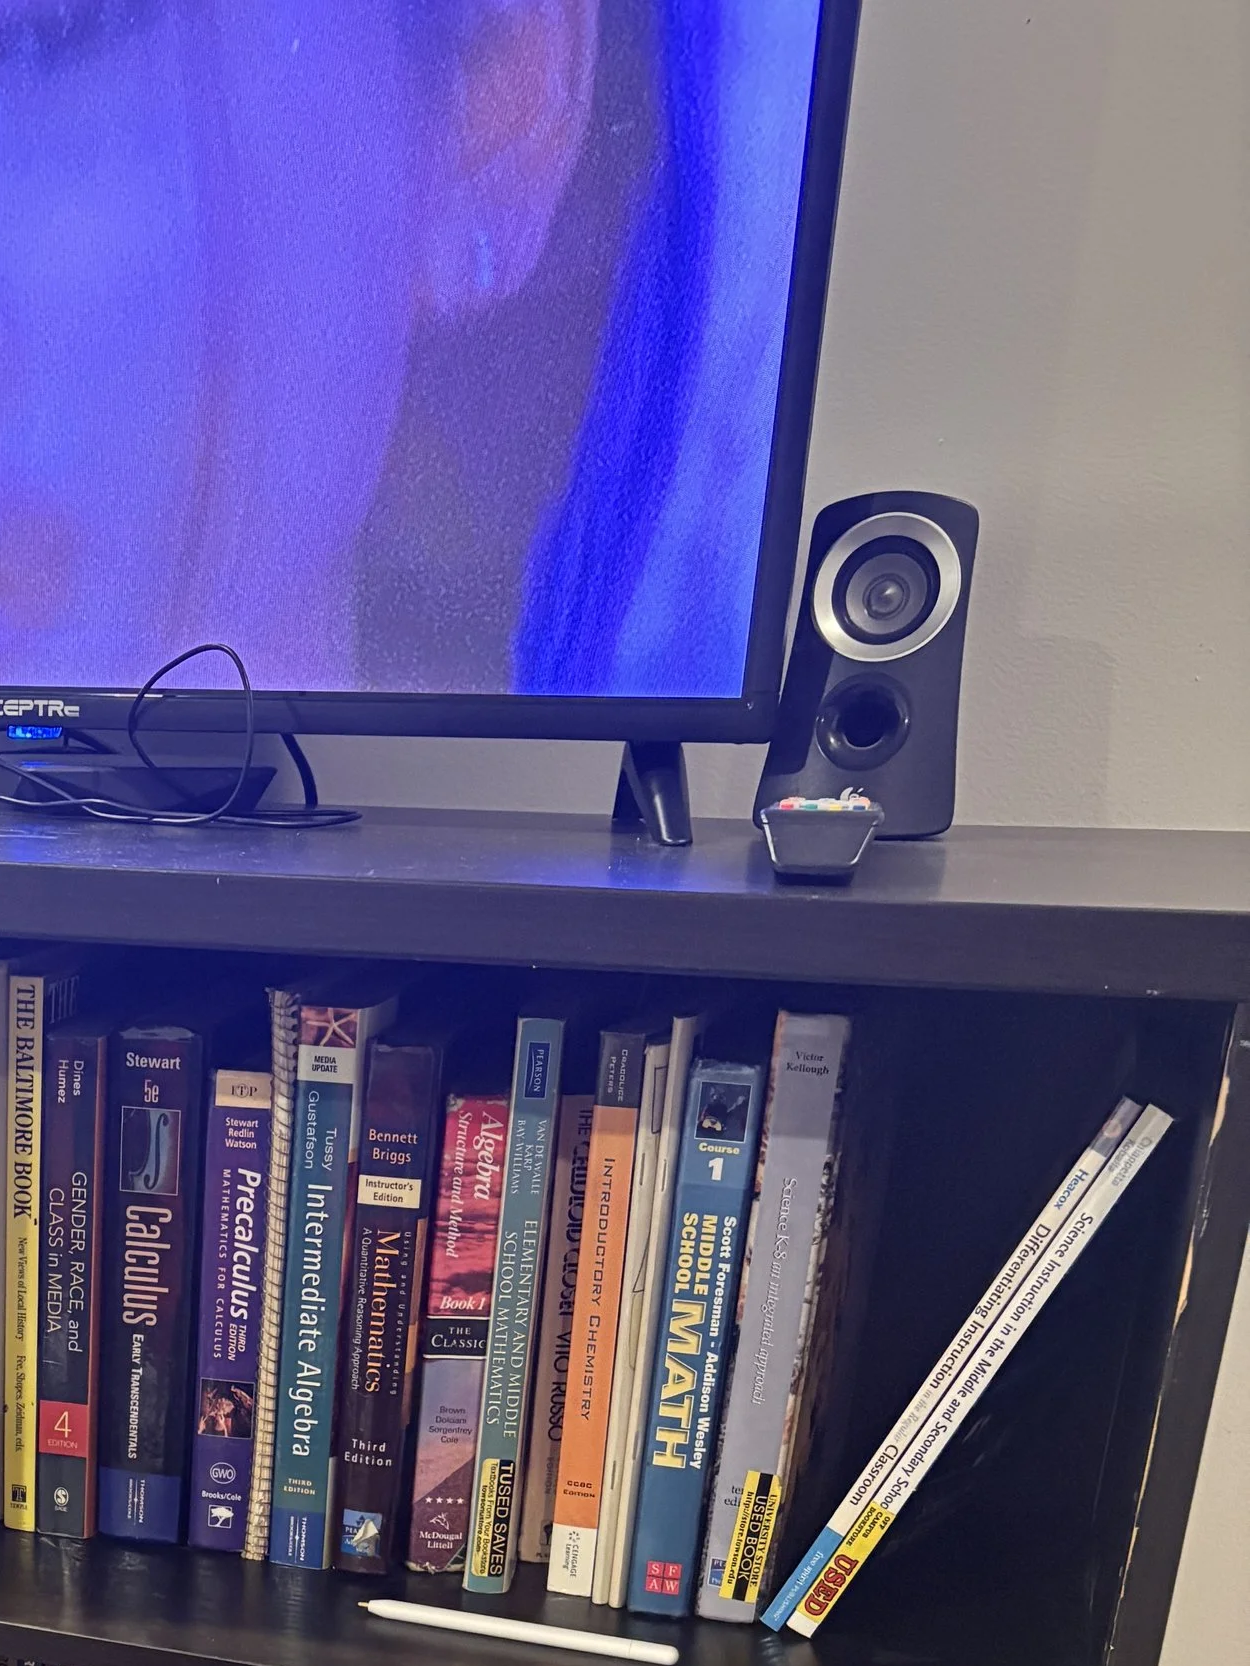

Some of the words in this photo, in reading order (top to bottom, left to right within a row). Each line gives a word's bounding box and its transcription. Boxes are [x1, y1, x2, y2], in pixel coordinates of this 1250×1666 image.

[16, 985, 36, 1030] THE
[73, 1060, 84, 1096] Dines
[125, 1051, 182, 1071] Stewart
[311, 1064, 338, 1074] UPDATE
[313, 1055, 337, 1065] MEDIA
[533, 1048, 545, 1093] PEARSON
[786, 1062, 830, 1076] Kellough
[795, 1051, 825, 1062] Victor
[14, 1036, 35, 1156] BALTIMORE
[57, 1059, 69, 1104] Humez
[144, 1079, 159, 1104] 5e
[225, 1117, 259, 1129] Stewart
[225, 1138, 257, 1150] Watson
[228, 1128, 255, 1139] Redlin
[304, 1090, 320, 1169] Gustafson
[369, 1128, 419, 1146] Bennett
[450, 1110, 473, 1175] Structure
[321, 1127, 338, 1172] Tussy
[372, 1147, 412, 1165] Briggs
[473, 1111, 505, 1201] Algebra
[510, 1119, 527, 1196] BAY-WILLIAMS
[699, 1142, 741, 1155] Course
[708, 1157, 725, 1181] 1
[13, 1162, 33, 1219] BOOK
[365, 1178, 414, 1192] Instructor's
[372, 1191, 404, 1203] Edition
[777, 1176, 798, 1232] Science
[1053, 1168, 1089, 1210] Heacox
[48, 1187, 65, 1247] CLASS
[70, 1171, 88, 1255] GENDER,
[218, 1168, 232, 1260] MATHEMATICS
[445, 1203, 462, 1259] Method
[591, 1157, 616, 1304] INTRODUCTORY
[1054, 1212, 1094, 1259] Science
[230, 1167, 262, 1320] Precalculus
[674, 1212, 699, 1294] SCHOOL
[693, 1214, 719, 1296] MIDDLE
[719, 1215, 738, 1259] Scott
[48, 1253, 63, 1268] in
[121, 1205, 173, 1327] Calculus
[216, 1267, 226, 1290] FOR
[297, 1183, 333, 1352] Intermediate
[495, 1231, 518, 1304] SCHOOL
[513, 1219, 538, 1329] ELEMENTARY
[974, 1222, 1053, 1319] Differentiating
[46, 1273, 63, 1333] MEDIA
[68, 1262, 86, 1313] RACE,
[439, 1295, 476, 1310] Book
[709, 1263, 732, 1338] Foresman
[1010, 1258, 1062, 1323] Instruction
[212, 1298, 225, 1359] CALCULUS
[364, 1228, 402, 1394] Mathematics
[449, 1326, 471, 1335] THE
[67, 1322, 84, 1353] and
[131, 1333, 144, 1367] EARLY
[227, 1323, 238, 1362] EDITION
[236, 1324, 248, 1352] THIRD
[430, 1334, 487, 1350] CLASSIC
[510, 1334, 527, 1368] AND
[929, 1319, 985, 1389] Instruction
[486, 1308, 509, 1425] MATHEMATICS
[579, 1315, 601, 1422] CHEMISTRY
[652, 1298, 707, 1470] MATH
[699, 1353, 719, 1414] Addison
[961, 1358, 993, 1399] Middle
[54, 1410, 72, 1438] 4
[127, 1367, 143, 1460] TRANSCENDENTALS
[288, 1359, 322, 1458] Algebra
[439, 1406, 466, 1415] Brown
[502, 1373, 523, 1438] MIDDLE
[942, 1398, 961, 1423] and
[47, 1439, 78, 1449] EDITION
[344, 1451, 392, 1468] Edition
[352, 1438, 386, 1453] Third
[689, 1416, 712, 1470] Wesley
[901, 1420, 948, 1477] Secondary
[201, 1490, 242, 1502] Brooks/Cole
[282, 1485, 316, 1496] EDITION
[287, 1477, 312, 1487] THIRD
[494, 1461, 515, 1516] TUSED
[849, 1443, 899, 1507] Classroom
[749, 1495, 768, 1532] USED
[419, 1530, 463, 1543] McDougal
[426, 1540, 453, 1550] Littell
[489, 1519, 508, 1577] SAVES
[737, 1534, 761, 1580] BOOK
[803, 1553, 859, 1617] USED
